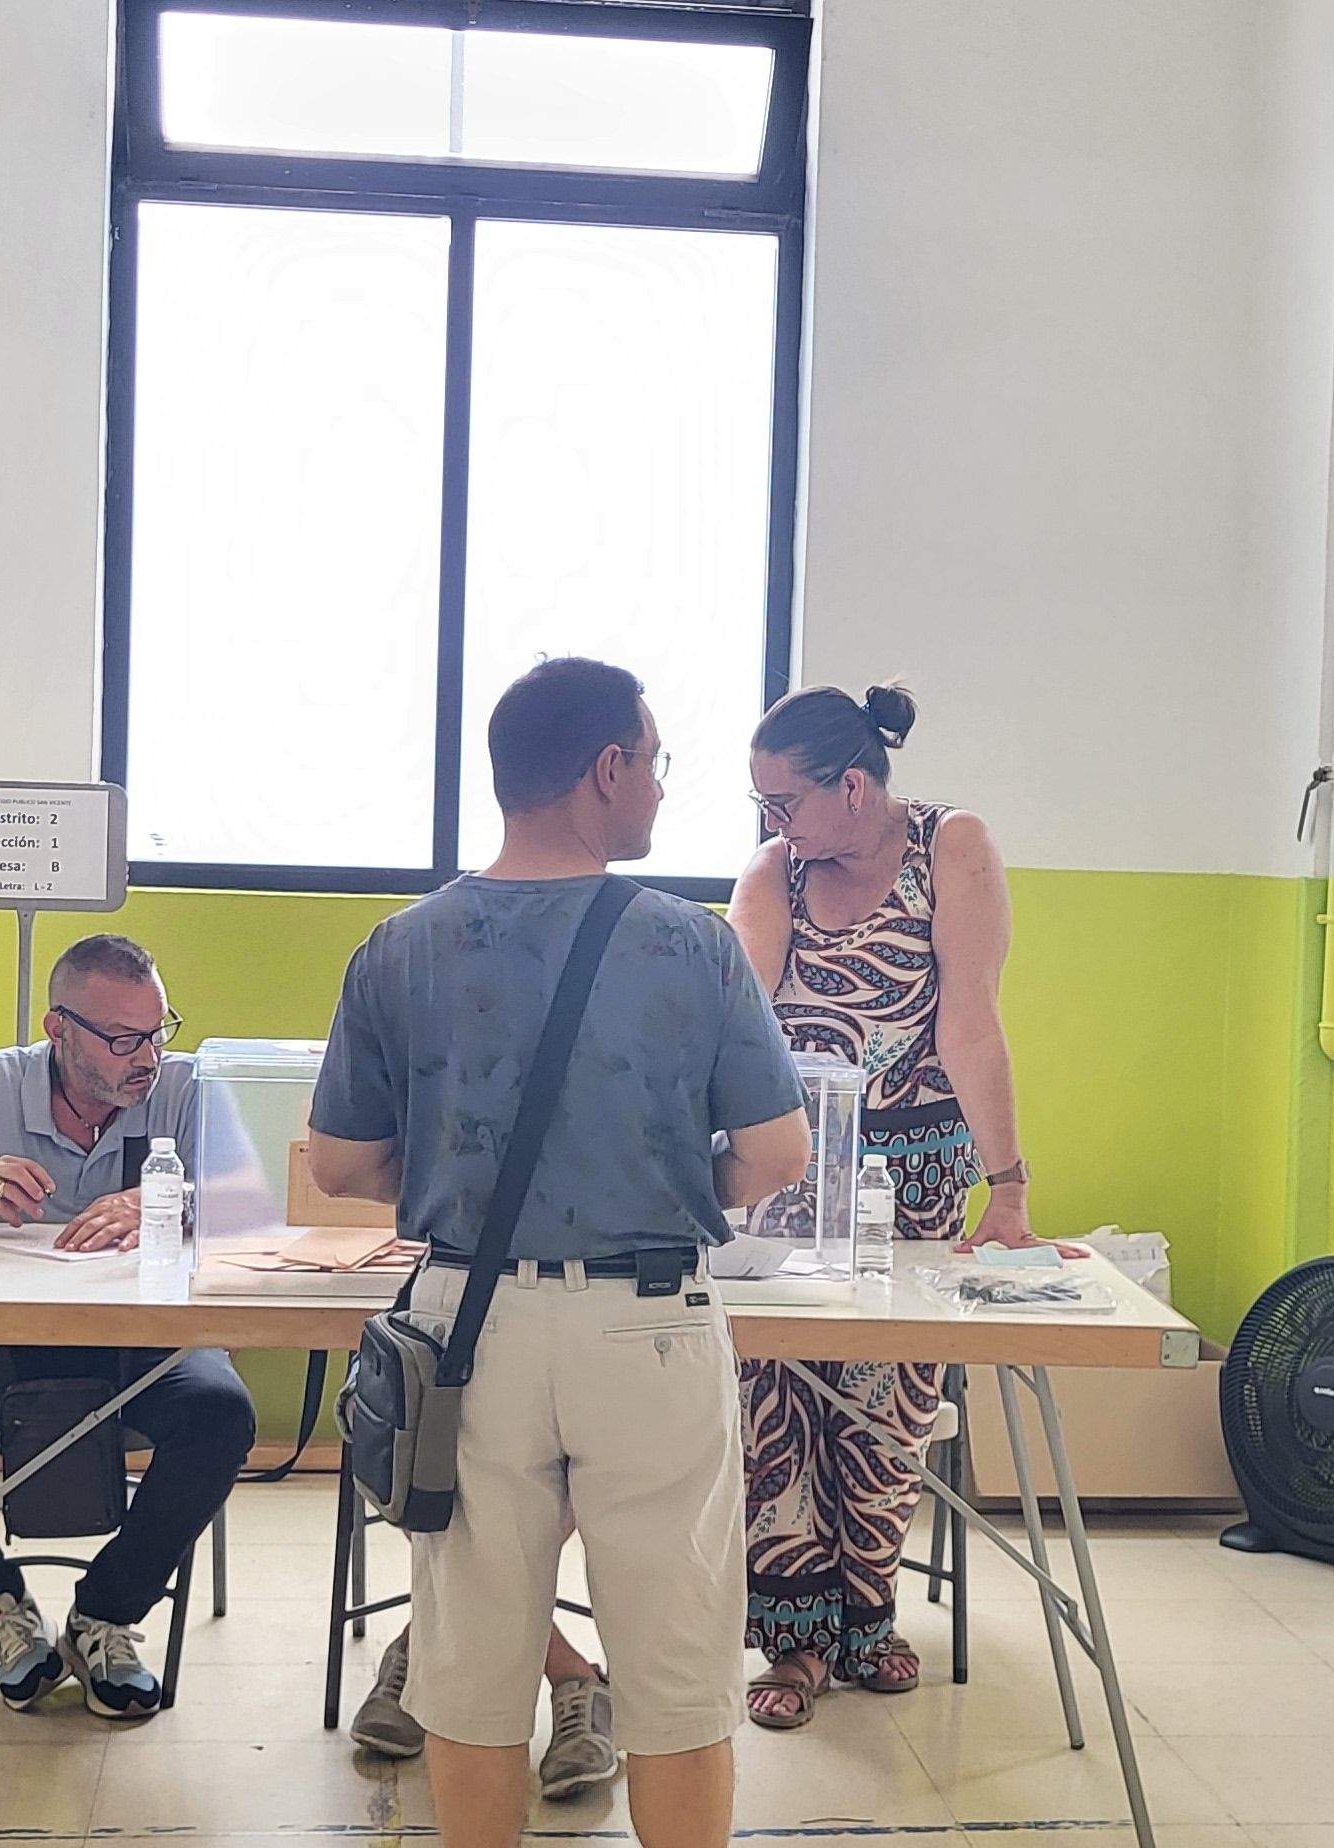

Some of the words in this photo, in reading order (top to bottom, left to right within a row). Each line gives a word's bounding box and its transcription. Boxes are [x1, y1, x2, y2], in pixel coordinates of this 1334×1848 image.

[50, 813, 58, 825] 2
[51, 837, 59, 849] 1
[51, 861, 60, 872] B
[0, 881, 25, 891] Letra:
